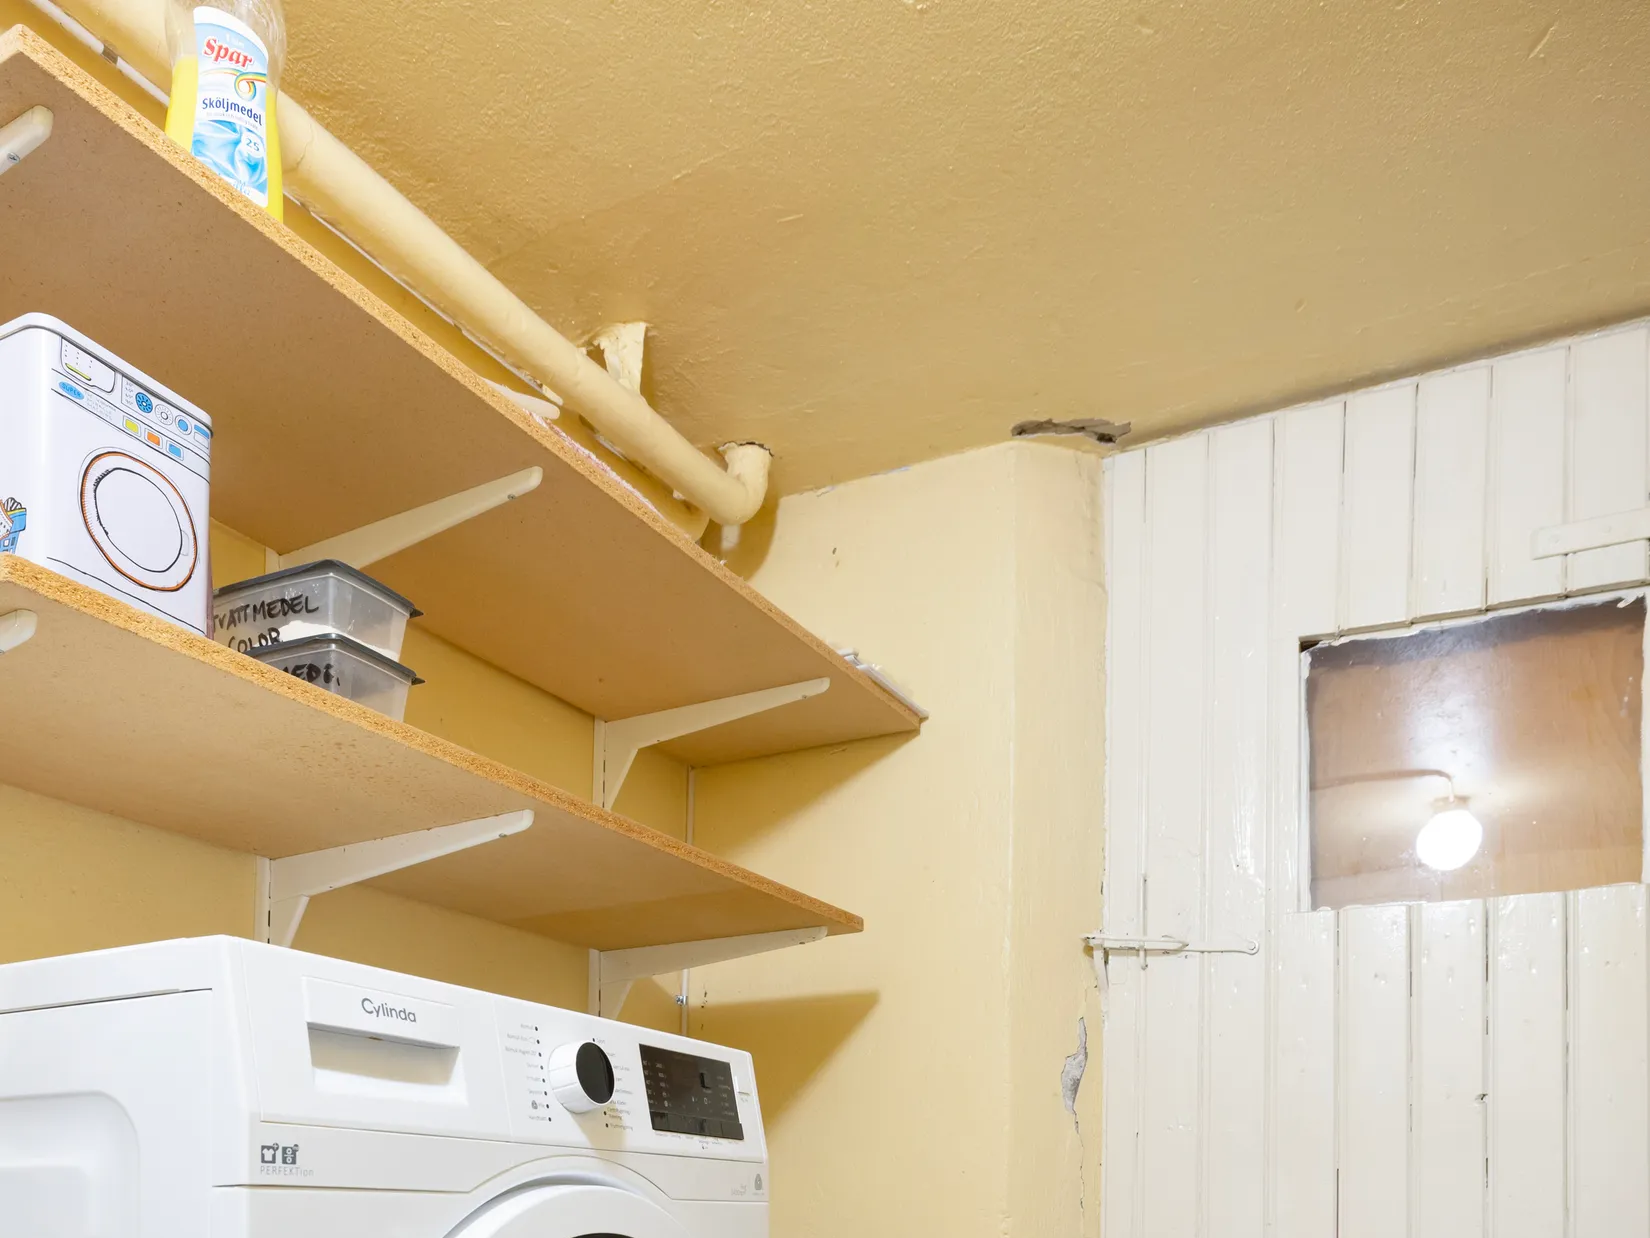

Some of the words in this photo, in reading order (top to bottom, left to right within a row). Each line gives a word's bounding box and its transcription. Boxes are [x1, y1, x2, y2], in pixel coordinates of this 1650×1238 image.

[203, 38, 253, 68] Spar
[202, 97, 263, 126] Sköljmedel
[61, 382, 82, 398] SUPER
[361, 997, 417, 1023] Cylinda
[260, 1165, 314, 1177] PERFEKTion
